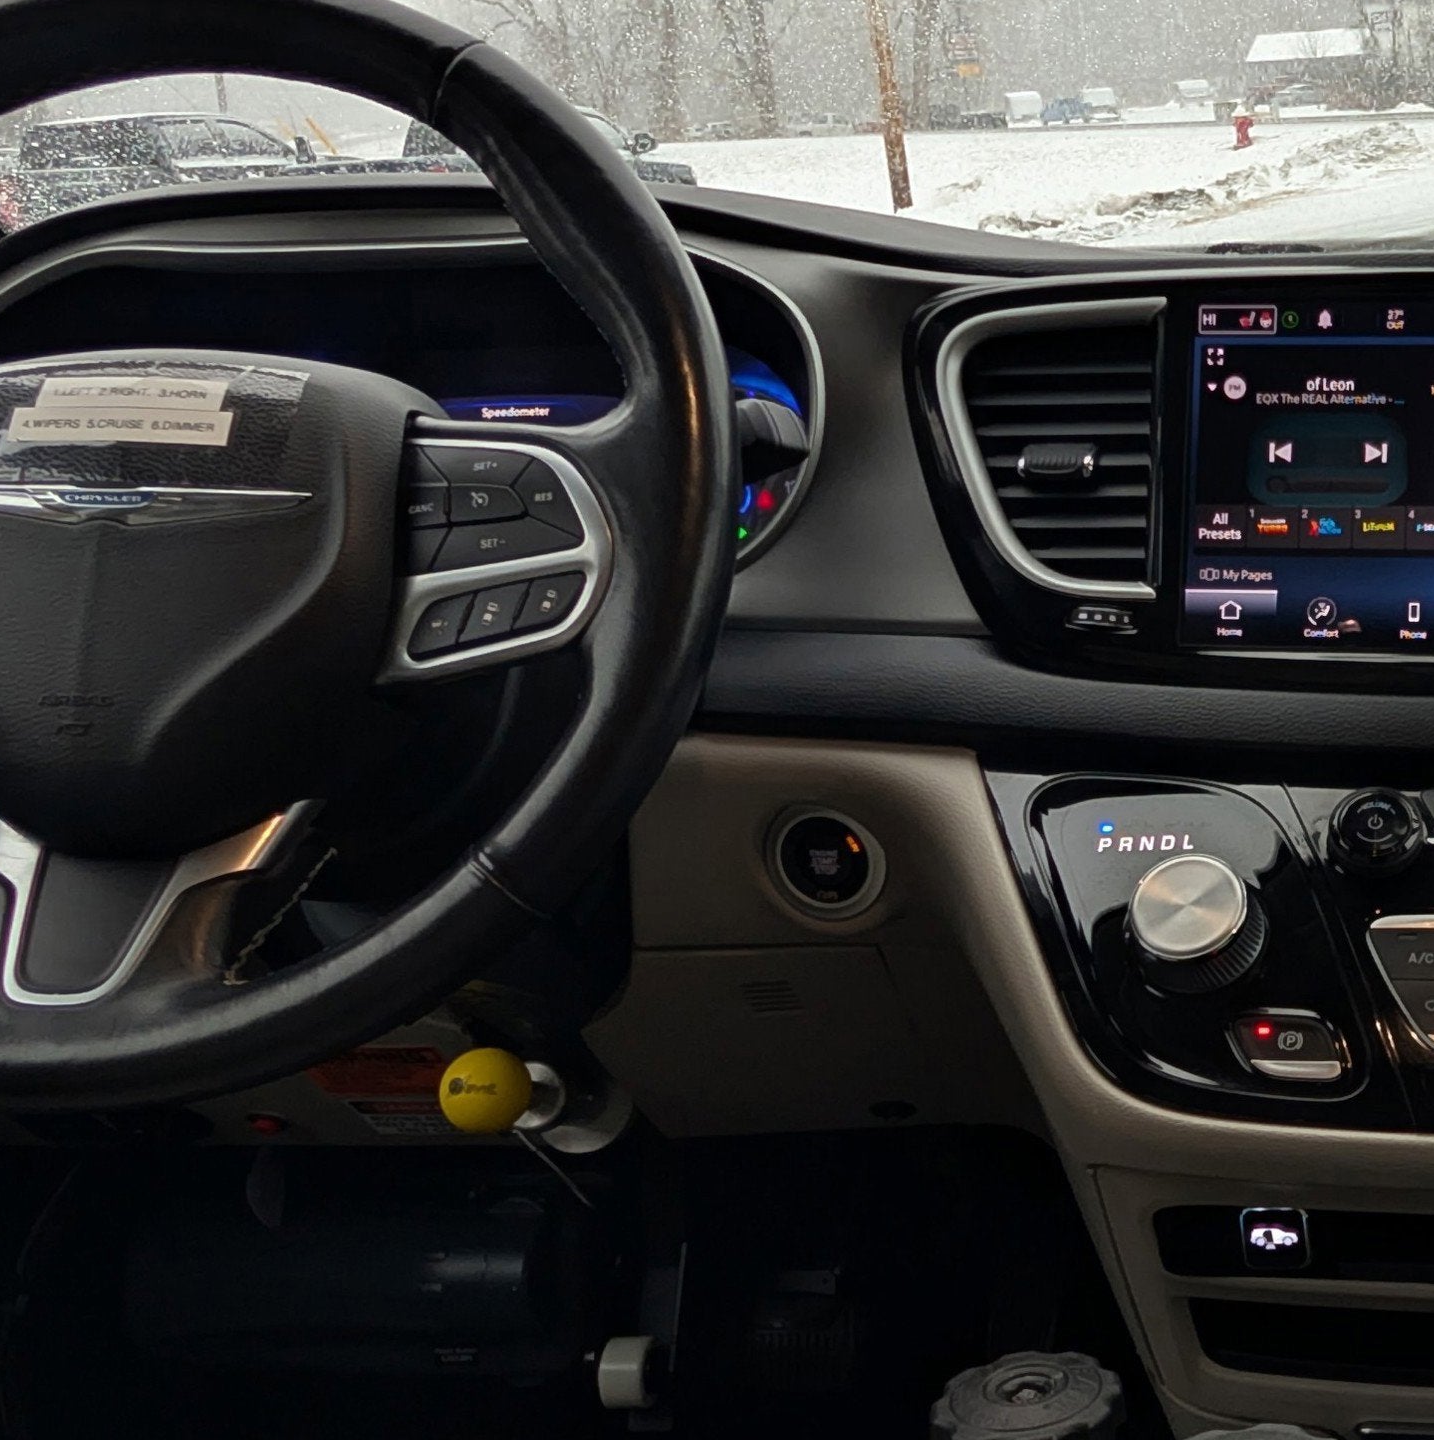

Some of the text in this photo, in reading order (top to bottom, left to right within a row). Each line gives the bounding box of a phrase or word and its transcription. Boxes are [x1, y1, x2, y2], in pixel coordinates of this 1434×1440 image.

[1203, 314, 1216, 326] HI
[1306, 376, 1355, 391] of Leon
[158, 388, 207, 400] 3.HORN
[1281, 393, 1300, 405] The
[1302, 394, 1328, 405] REAL
[1330, 393, 1386, 405] Alternative
[481, 406, 550, 419] Speedometer
[23, 419, 215, 432] 4.WIPERS 5.CRUISE 6.DIMMER
[65, 494, 142, 502] CHRYSLER
[534, 492, 553, 502] RES
[1213, 513, 1229, 525] All
[1301, 510, 1308, 518] 2
[1354, 510, 1361, 518] 3
[1408, 510, 1415, 518] 4
[1198, 528, 1242, 540] Presets
[1223, 570, 1272, 582] My Pages
[1216, 628, 1243, 637] Home
[1303, 628, 1339, 638] Comfort
[1399, 630, 1427, 640] Phone
[1408, 953, 1434, 964] A/C
